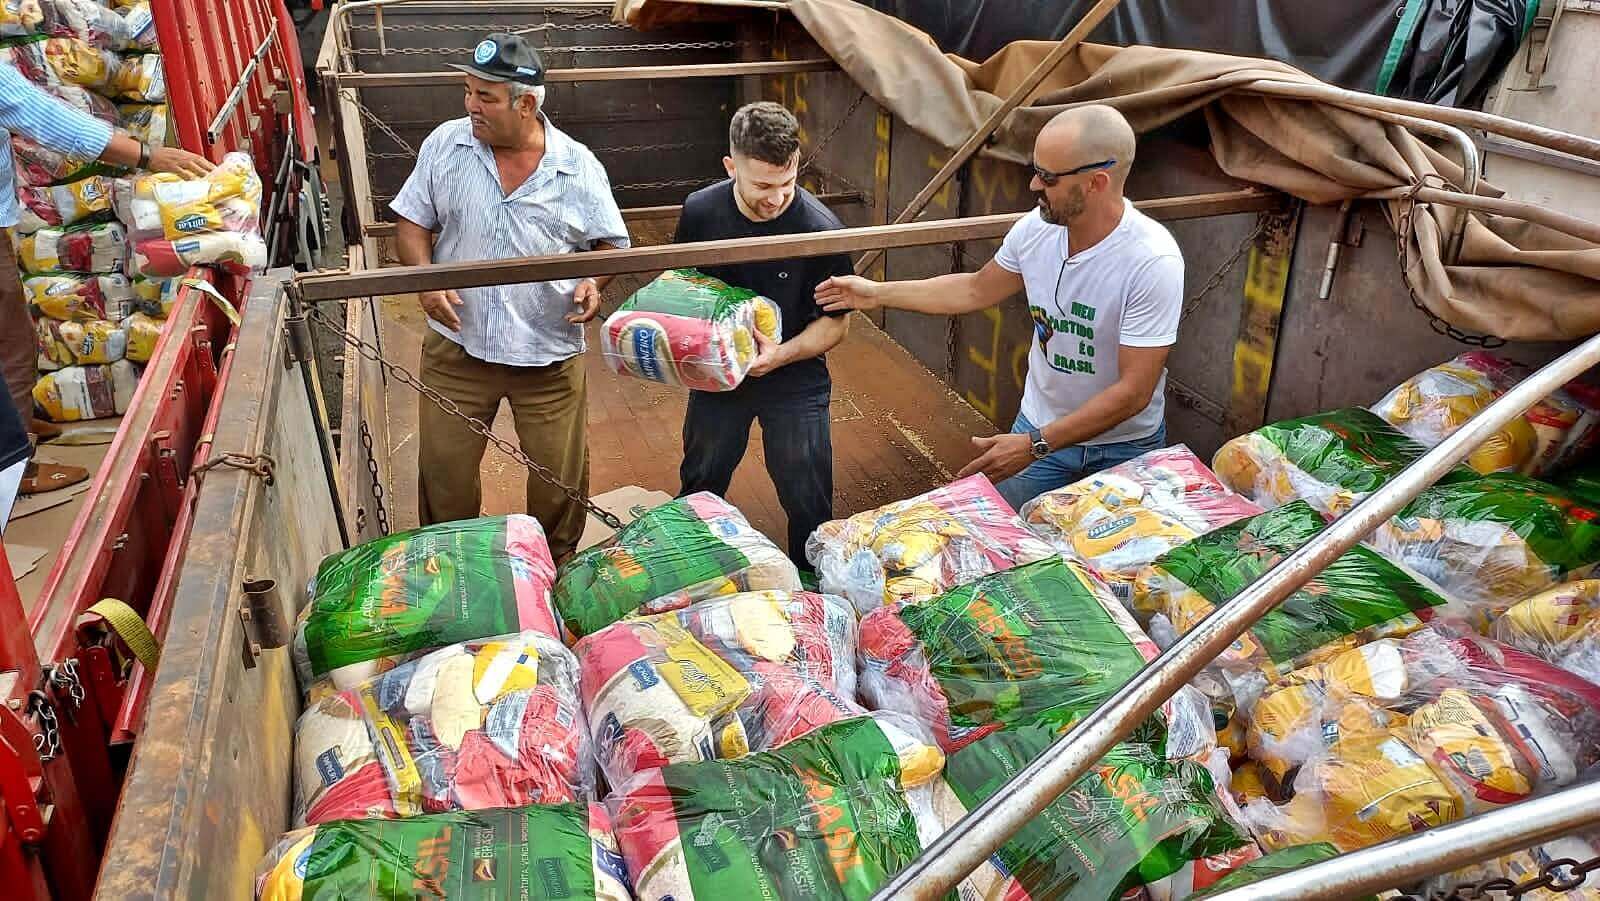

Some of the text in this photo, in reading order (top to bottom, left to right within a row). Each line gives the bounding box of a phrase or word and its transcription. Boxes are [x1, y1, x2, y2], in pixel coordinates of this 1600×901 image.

[1071, 301, 1096, 321] MEU
[1079, 340, 1095, 357] É O
[1053, 353, 1096, 375] BRASIL
[482, 826, 494, 858] BRASIL
[786, 849, 809, 896] BRASIL
